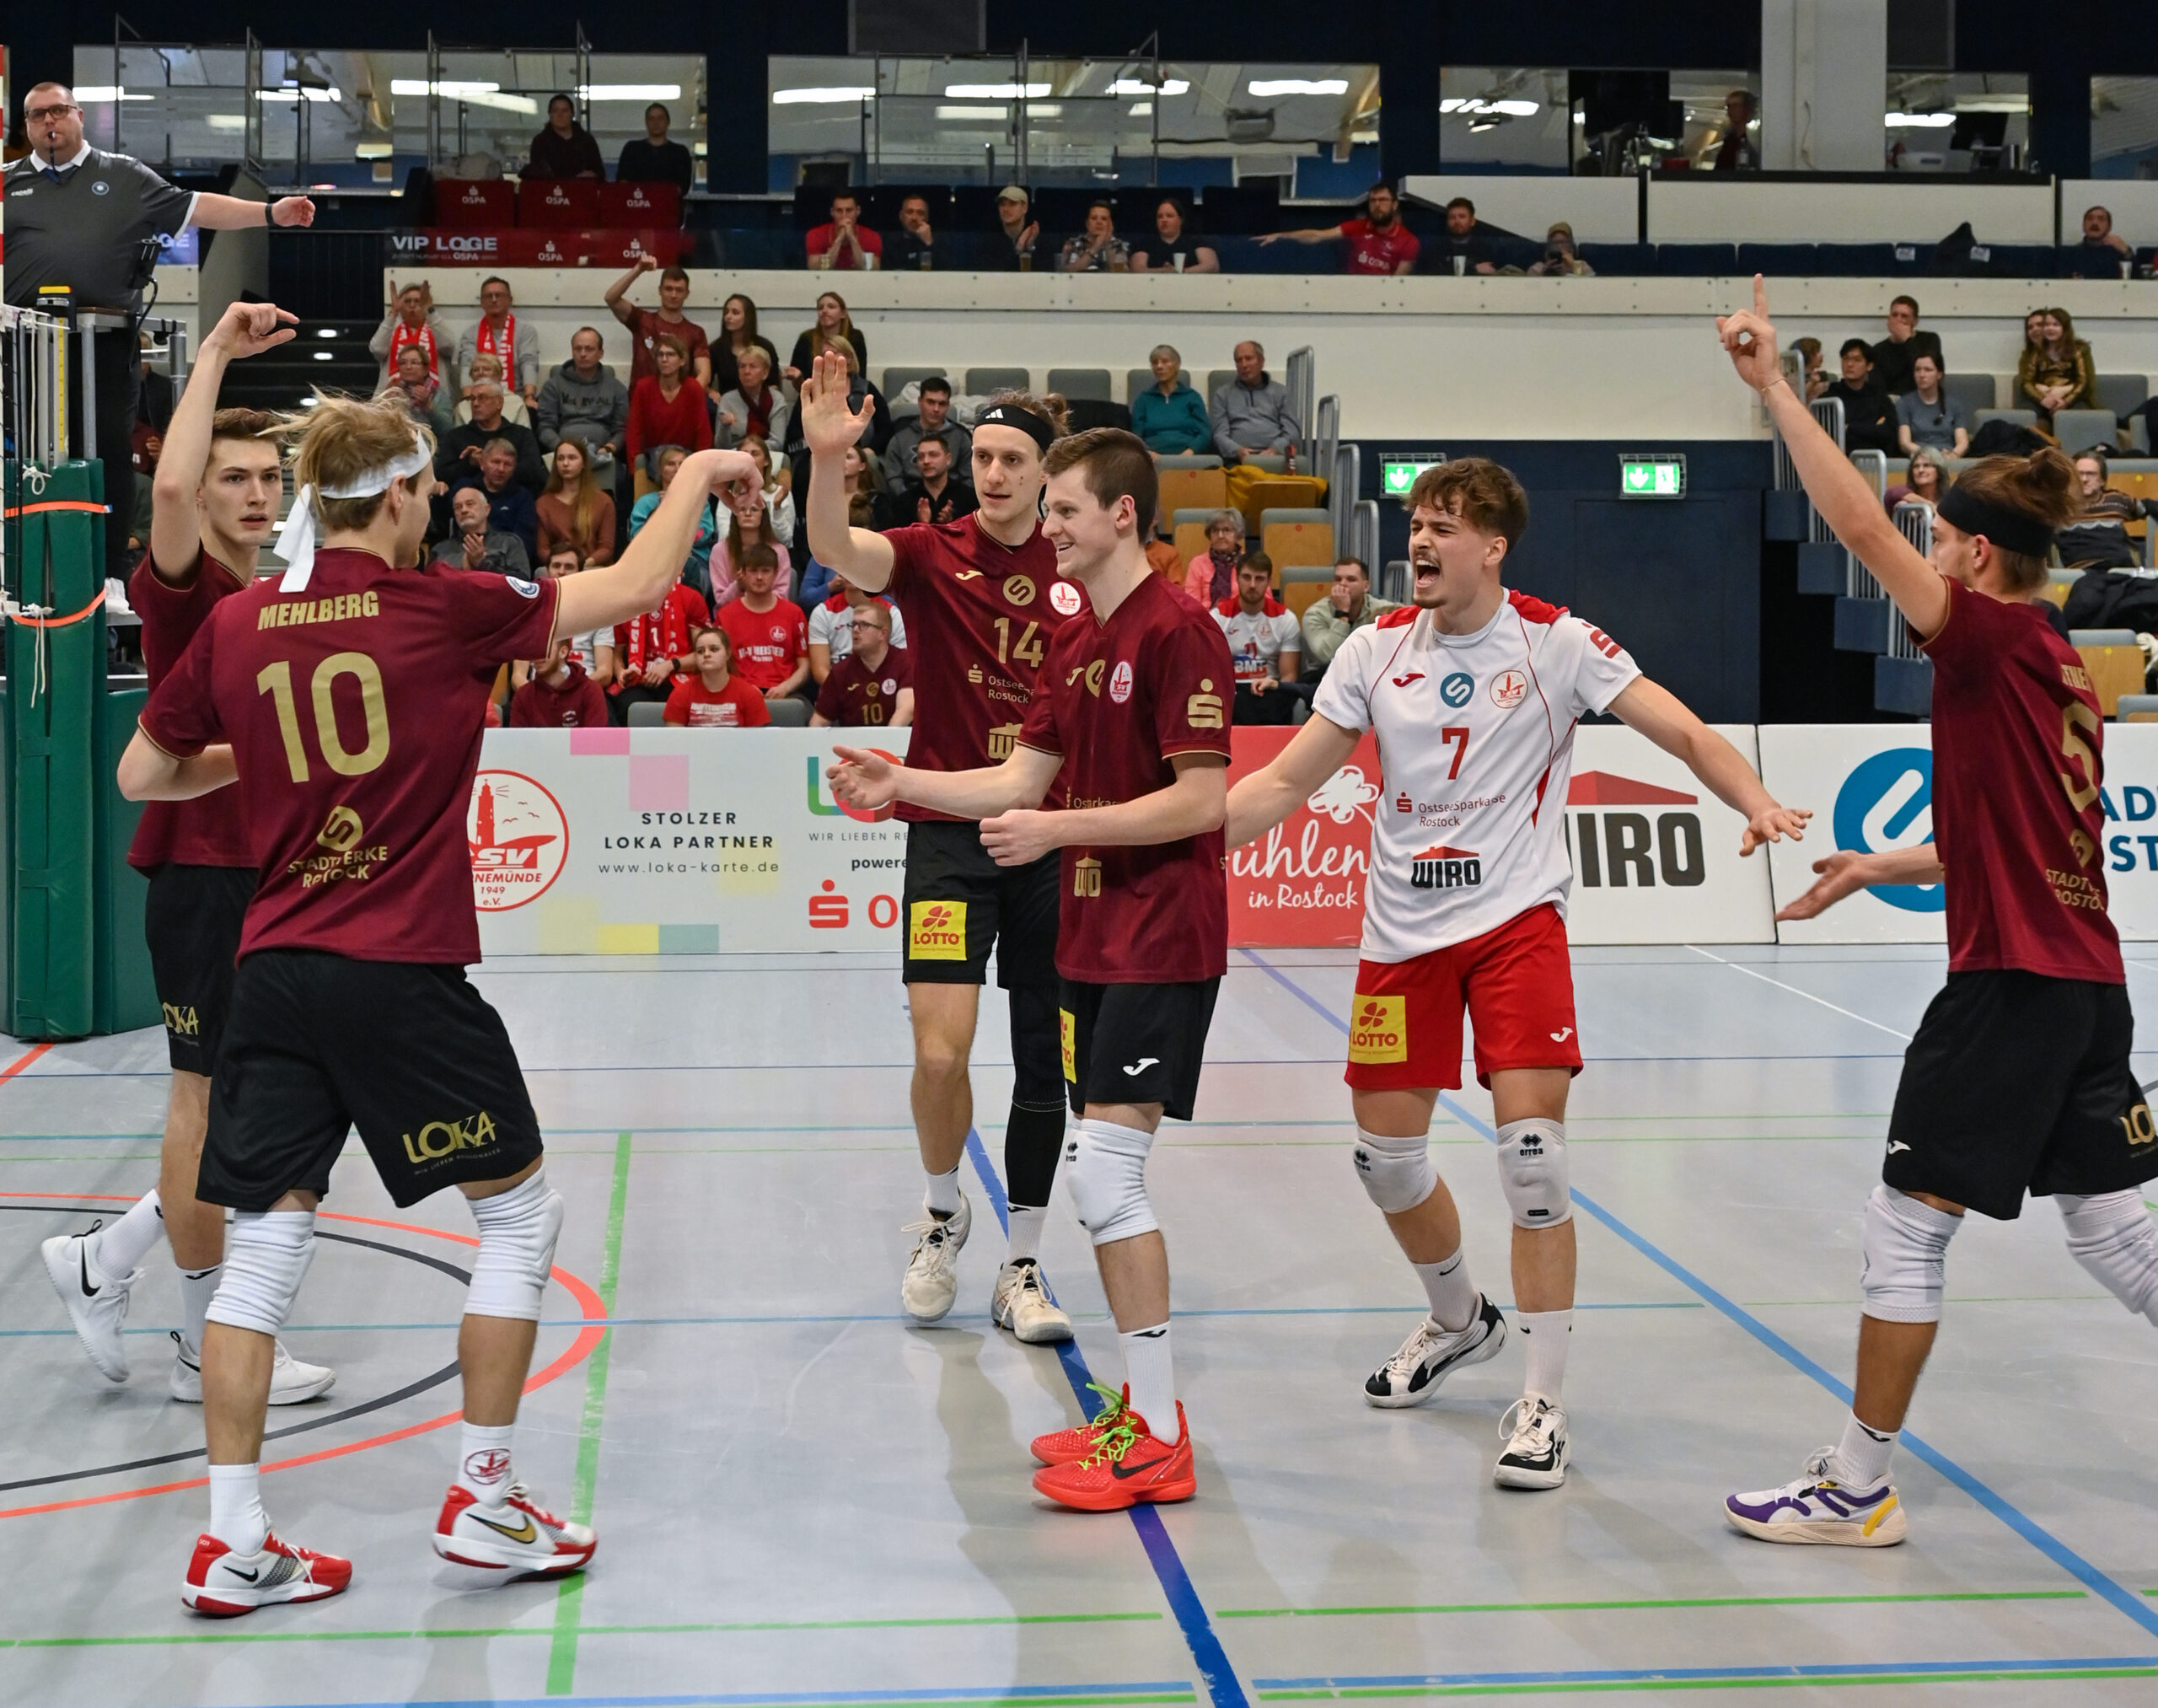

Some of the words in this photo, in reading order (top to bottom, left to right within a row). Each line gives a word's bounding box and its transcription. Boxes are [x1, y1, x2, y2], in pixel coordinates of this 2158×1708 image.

[462, 196, 486, 204] OSPA
[546, 196, 570, 206] OSPA
[626, 199, 651, 208] OSPA
[392, 236, 429, 250] VIP
[436, 237, 497, 251] LOGE
[538, 252, 563, 262] OSPA
[257, 591, 379, 631] MEHLBERG
[994, 617, 1044, 668] 14
[988, 689, 1029, 705] Rostock
[256, 652, 390, 783] 10
[862, 702, 883, 724] 10
[1442, 728, 1469, 780] 7
[2060, 699, 2100, 813] 5
[2100, 786, 2158, 822] AD
[641, 812, 737, 824] STOLZER
[1420, 816, 1461, 828] Rostock
[604, 836, 663, 849] LOKA
[674, 835, 773, 849] PARTNER
[808, 832, 835, 841] WIR
[841, 831, 887, 841] LIEBEN
[894, 831, 908, 841] RE
[1232, 819, 1369, 878] ühlen
[1565, 812, 1705, 888] IRO
[599, 862, 779, 873] www.loka-karte.de
[851, 857, 907, 872] powere
[475, 870, 542, 883] NEMÜNDE
[1411, 859, 1481, 889] WIRO
[480, 886, 506, 894] 1949
[1248, 890, 1274, 909] in
[1277, 880, 1359, 910] Rostock
[483, 897, 502, 905] e.V.
[914, 932, 959, 945] LOTTO
[162, 1002, 199, 1035] OKA
[1352, 1031, 1398, 1047] LOTTO
[2118, 1104, 2156, 1145] LO
[402, 1111, 496, 1163] LOKA
[1520, 1147, 1543, 1157] errea
